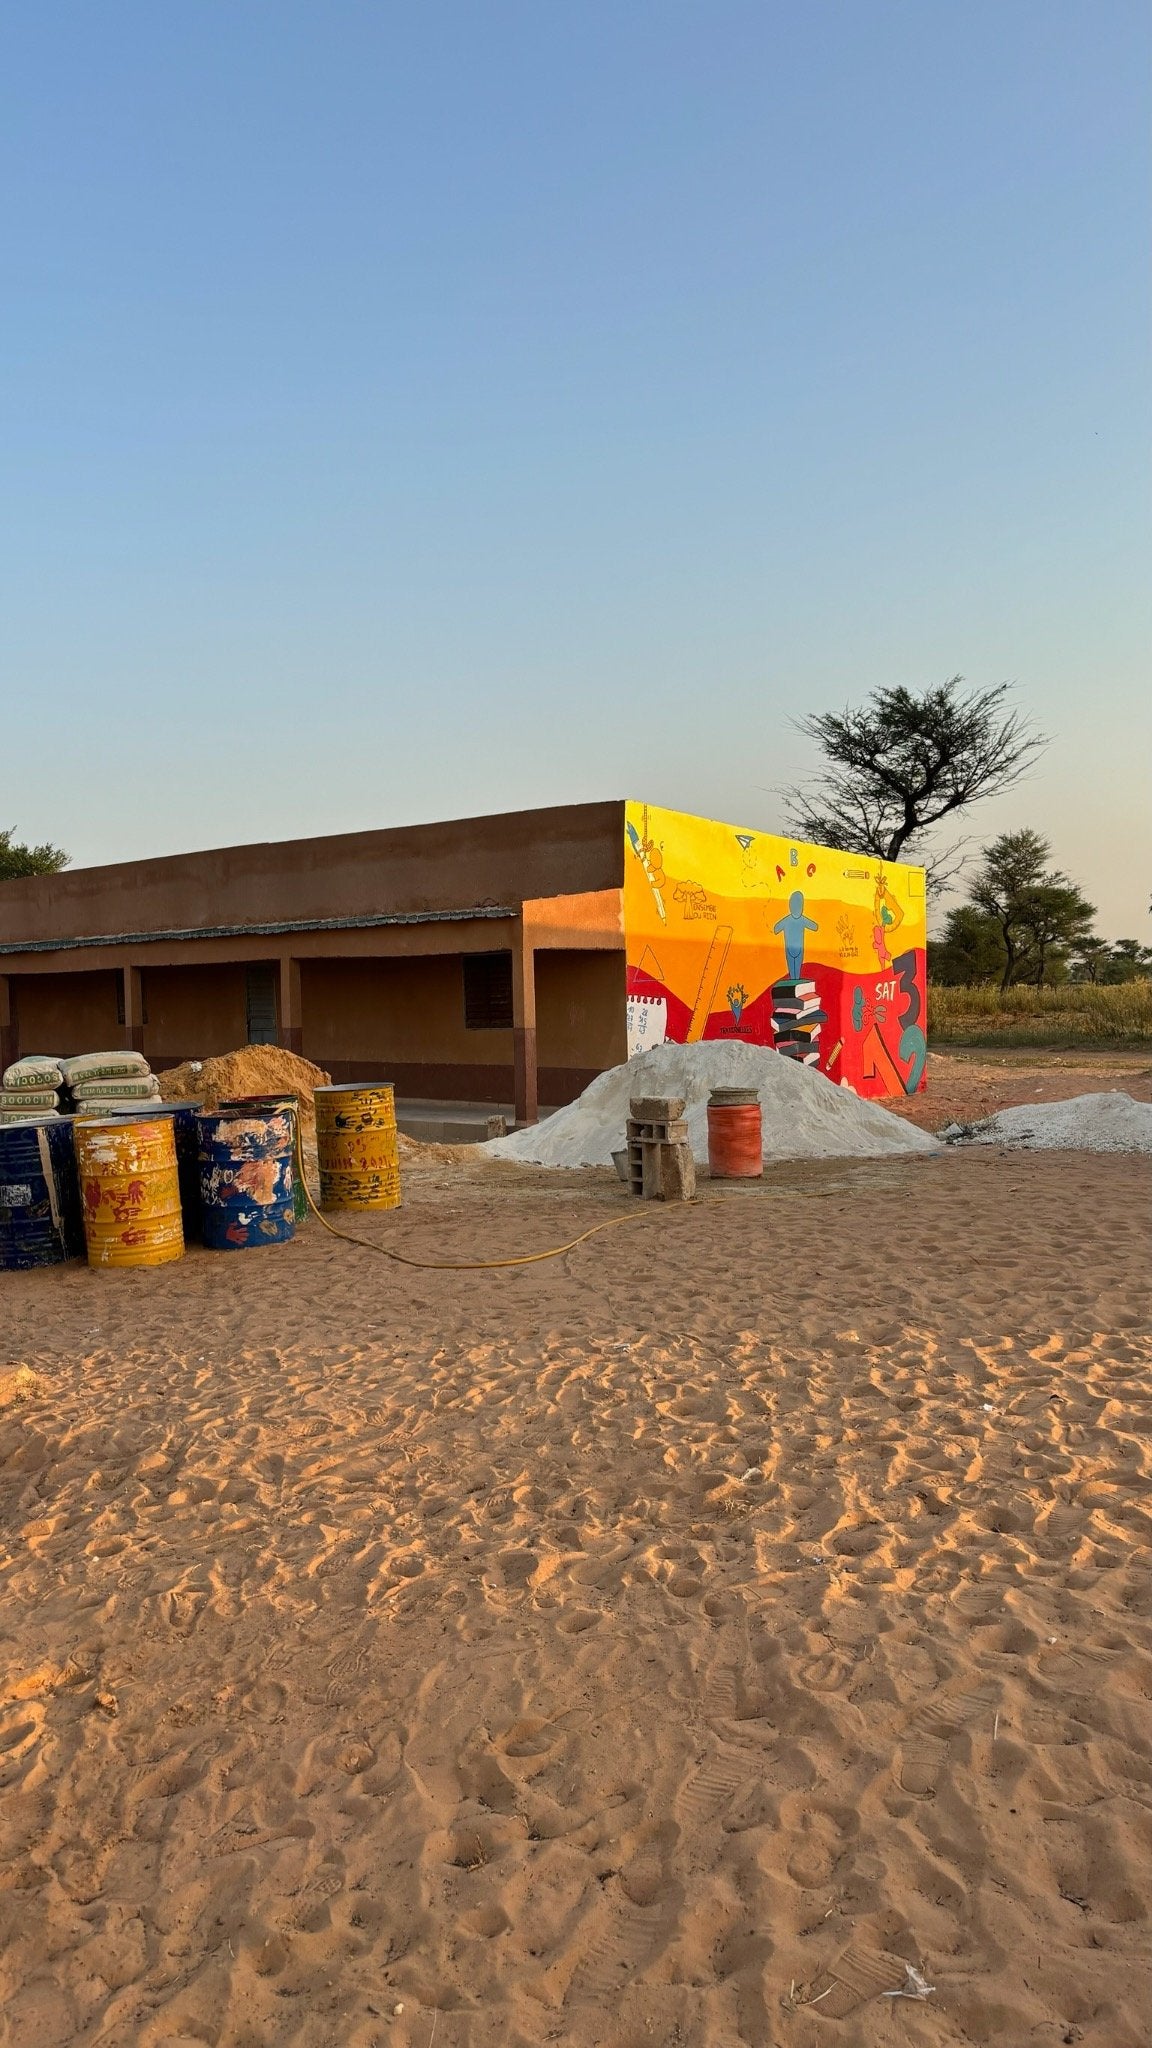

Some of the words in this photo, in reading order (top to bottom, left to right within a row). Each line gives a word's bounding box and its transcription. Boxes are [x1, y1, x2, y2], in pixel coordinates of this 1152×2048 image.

[790, 848, 799, 867] B
[875, 981, 897, 1001] SAT
[891, 949, 921, 1032] 3
[2, 1096, 54, 1105] SOCOCIM
